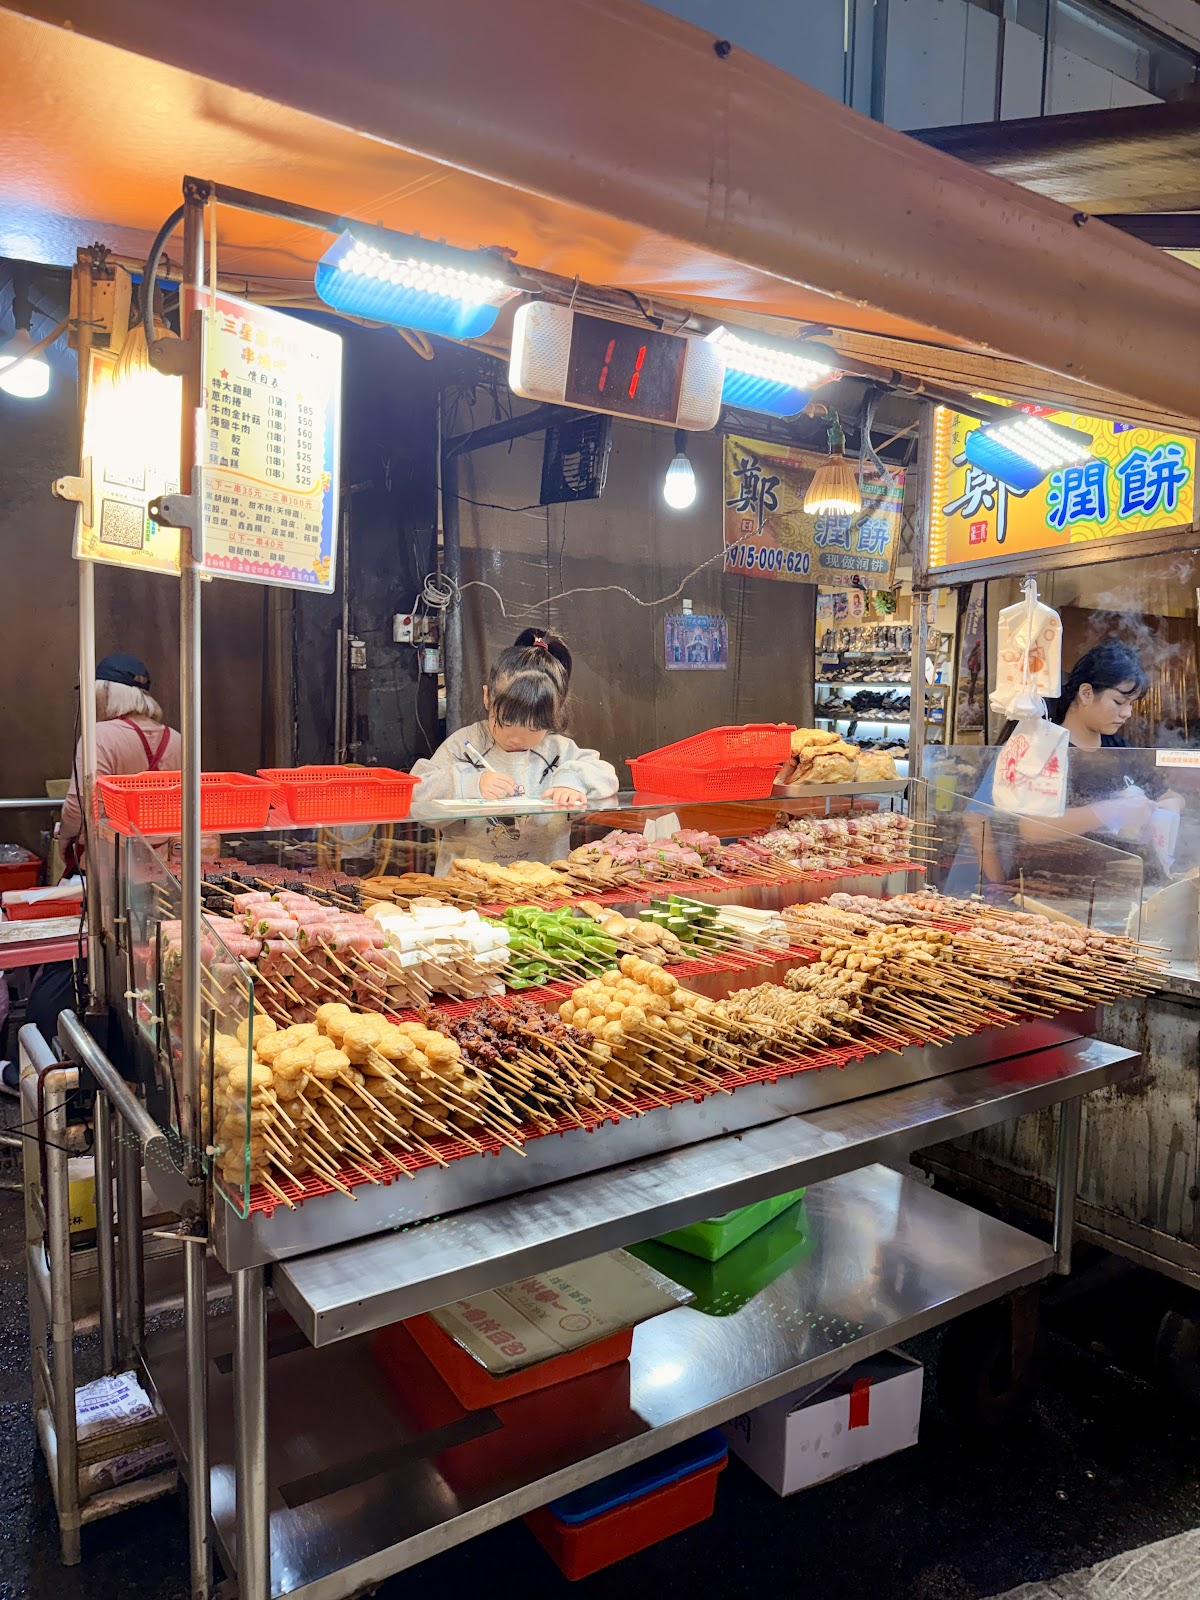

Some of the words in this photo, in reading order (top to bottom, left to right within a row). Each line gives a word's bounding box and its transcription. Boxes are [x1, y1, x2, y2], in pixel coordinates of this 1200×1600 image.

[211, 378, 252, 398] 特大雞腿
[298, 404, 313, 415] $85
[210, 416, 251, 434] 海鹽牛肉
[297, 440, 312, 450] $50
[211, 404, 261, 426] 牛肉金針菇
[297, 428, 312, 439] $60
[298, 416, 313, 427] $50
[296, 451, 312, 462] $25
[296, 463, 311, 474] $25
[296, 475, 311, 486] $25
[1047, 442, 1190, 532] 潤餅
[726, 455, 781, 537] 鄭
[229, 532, 286, 550] 以下一串40元
[814, 514, 890, 555] 潤餅
[825, 554, 884, 572] 现做润饼
